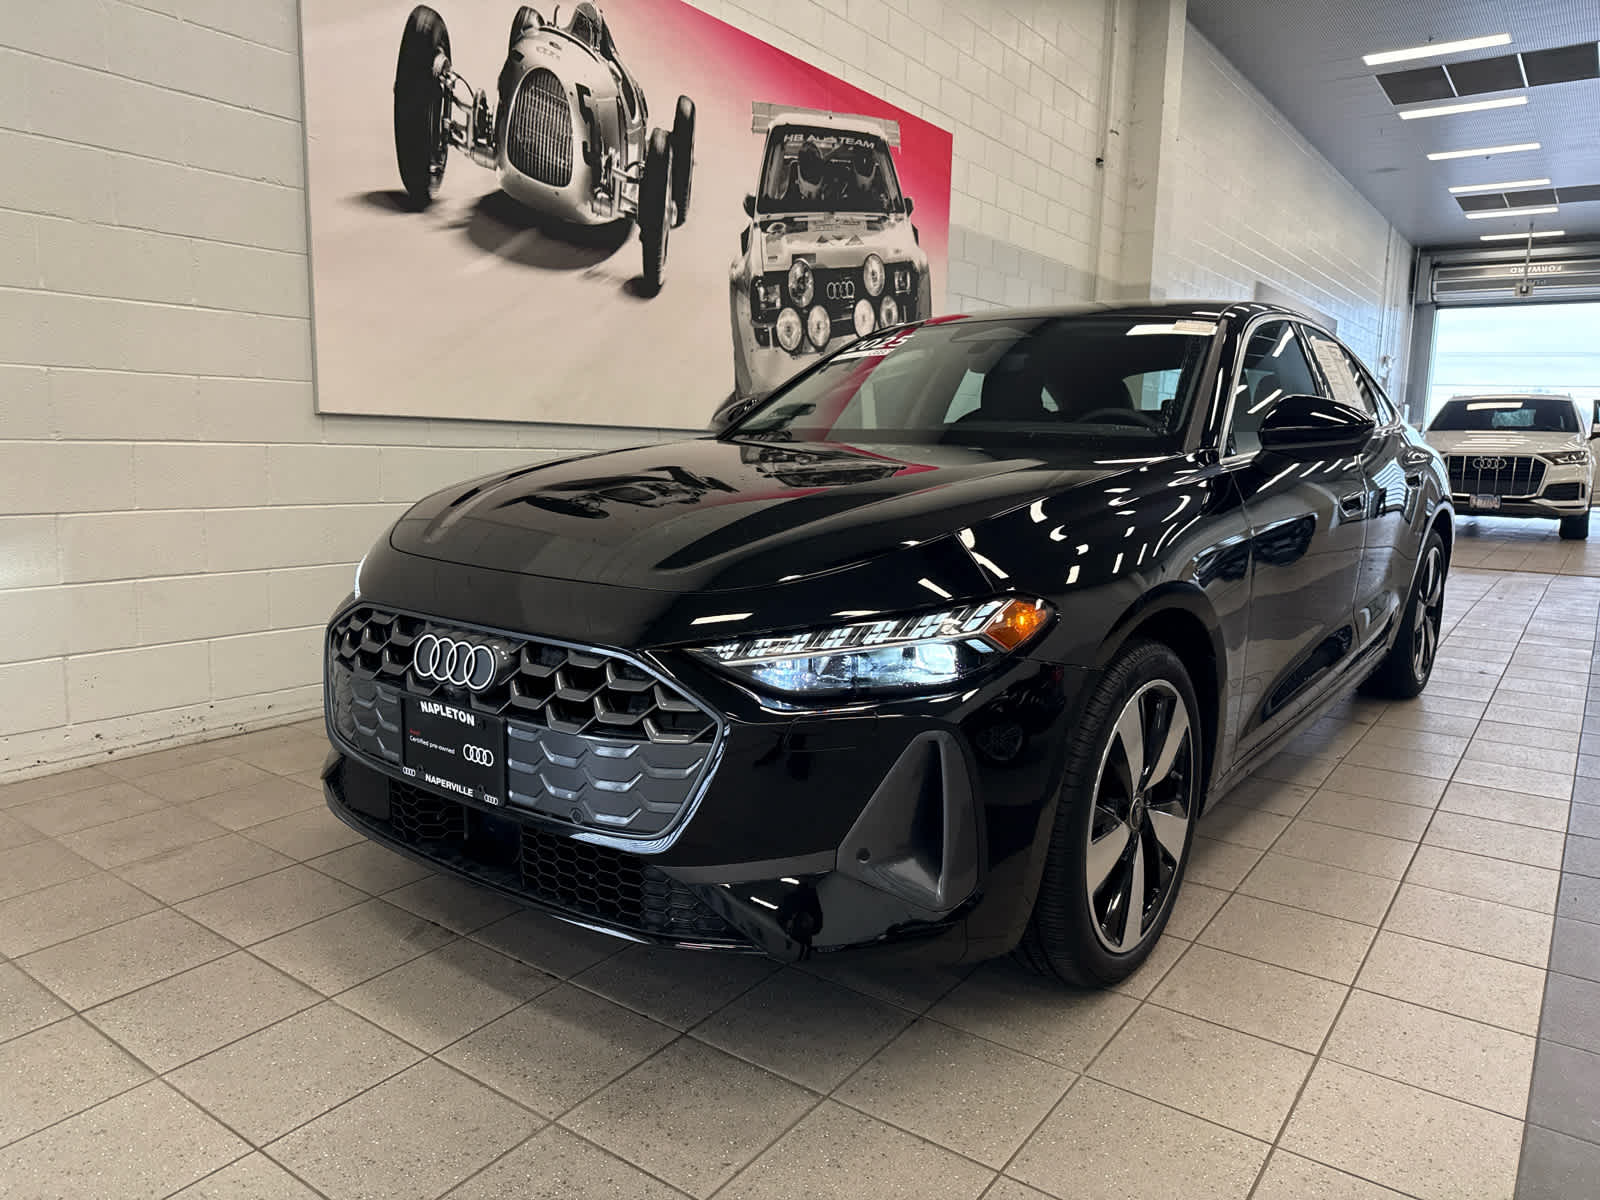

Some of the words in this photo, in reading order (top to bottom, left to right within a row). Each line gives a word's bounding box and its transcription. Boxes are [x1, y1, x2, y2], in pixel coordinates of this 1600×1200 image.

[839, 136, 875, 149] TEAM
[420, 701, 475, 726] NAPLETON
[425, 773, 474, 797] NAPERVILLE
